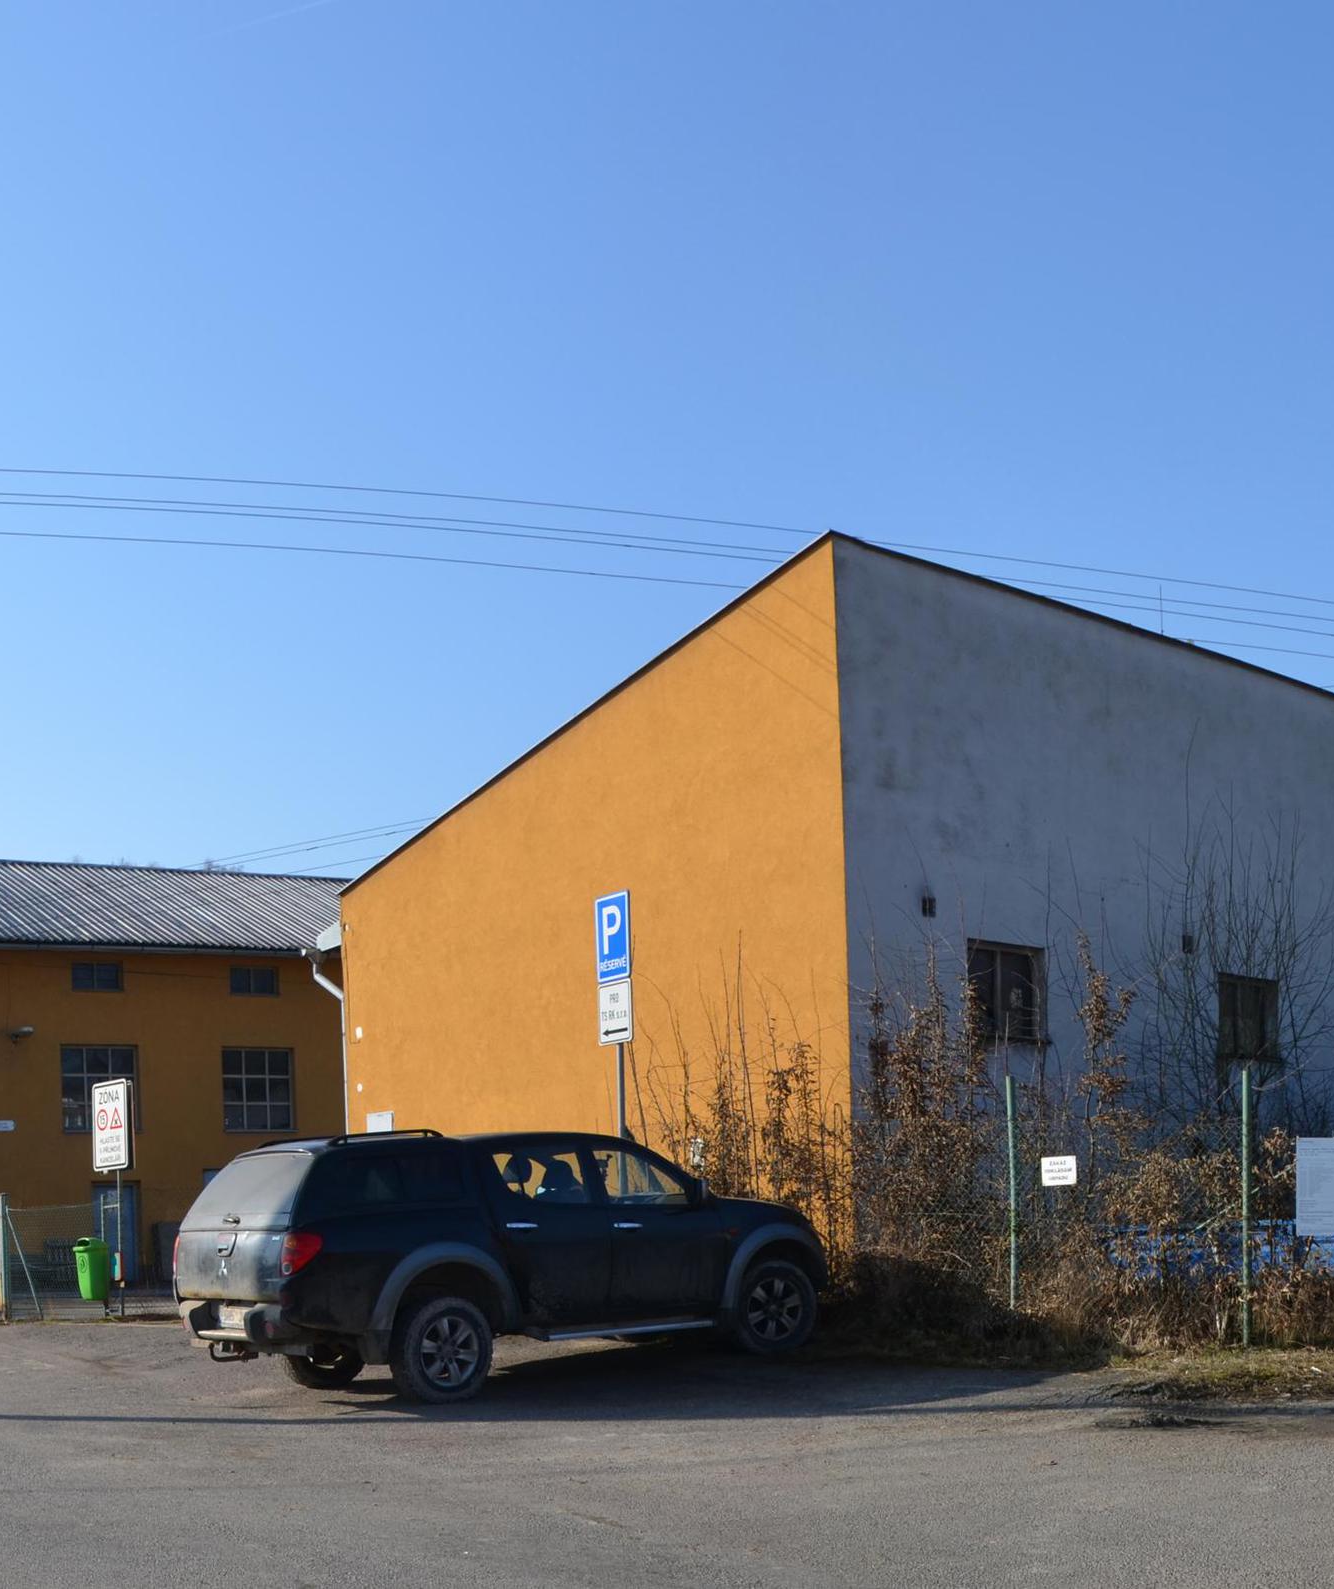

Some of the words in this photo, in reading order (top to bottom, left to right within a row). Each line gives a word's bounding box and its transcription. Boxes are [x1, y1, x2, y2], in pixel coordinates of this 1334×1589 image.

[602, 905, 621, 955] P
[99, 1089, 120, 1105] ZÓNA
[99, 1114, 106, 1125] 15
